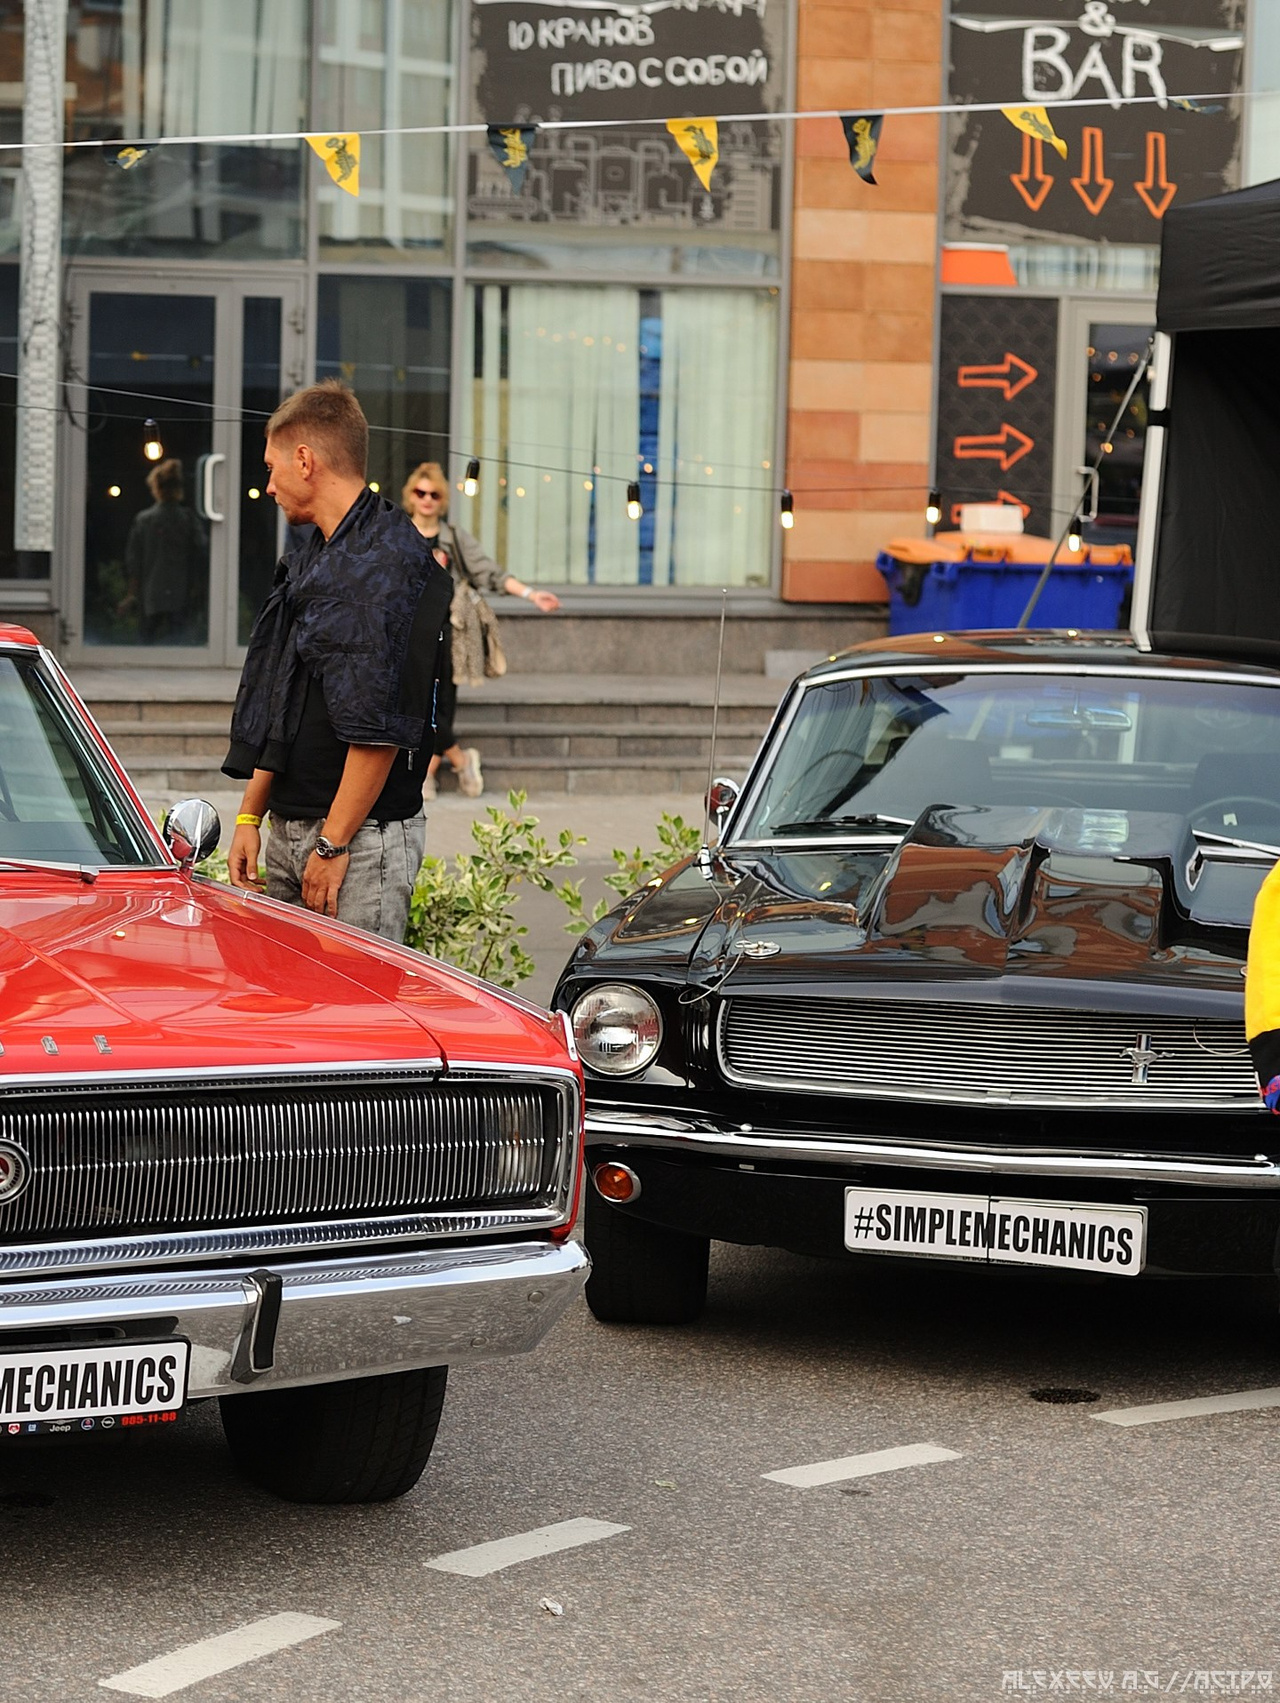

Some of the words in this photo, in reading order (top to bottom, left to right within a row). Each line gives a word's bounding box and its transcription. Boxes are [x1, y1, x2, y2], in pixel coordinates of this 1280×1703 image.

[508, 20, 535, 50] 10
[538, 14, 655, 49] КРАНОВ
[551, 58, 637, 96] ПИВО
[638, 57, 664, 88] С
[665, 48, 768, 87] СОБОЙ
[1022, 25, 1168, 110] BAR
[854, 1203, 1134, 1265] #SIMPLEMECHANICS
[49, 1424, 71, 1432] Jeep
